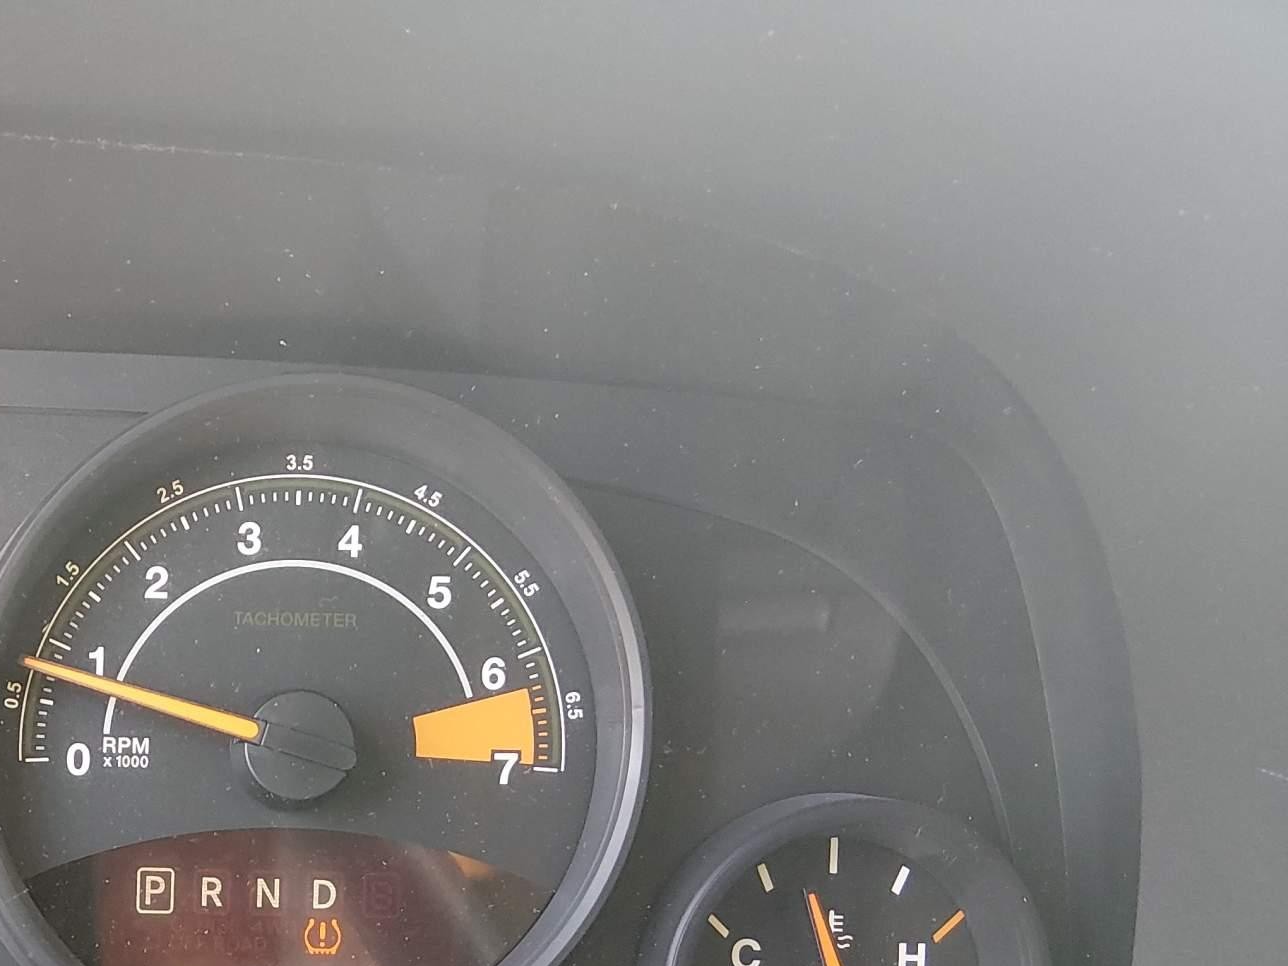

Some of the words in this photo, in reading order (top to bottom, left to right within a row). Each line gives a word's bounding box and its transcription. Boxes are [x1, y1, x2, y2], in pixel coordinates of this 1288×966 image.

[286, 455, 313, 470] 3.5
[158, 481, 184, 504] 2.5
[413, 484, 441, 508] 4.5
[238, 522, 262, 554] 3
[337, 526, 362, 558] 4
[56, 561, 80, 587] 1.5
[144, 567, 168, 599] 2
[513, 570, 539, 598] 5.5
[427, 576, 452, 608] 5
[233, 611, 357, 627] TACHOMETER
[89, 647, 104, 675] 1
[482, 657, 506, 690] 6
[4, 682, 21, 709] 0.5
[565, 692, 583, 719] 6.5
[67, 743, 90, 776] 0
[102, 737, 149, 754] RPM
[116, 756, 149, 768] 1000
[494, 753, 519, 784] 7
[145, 876, 164, 904] P
[202, 877, 222, 907] R
[256, 878, 280, 908] N
[313, 879, 336, 909] D
